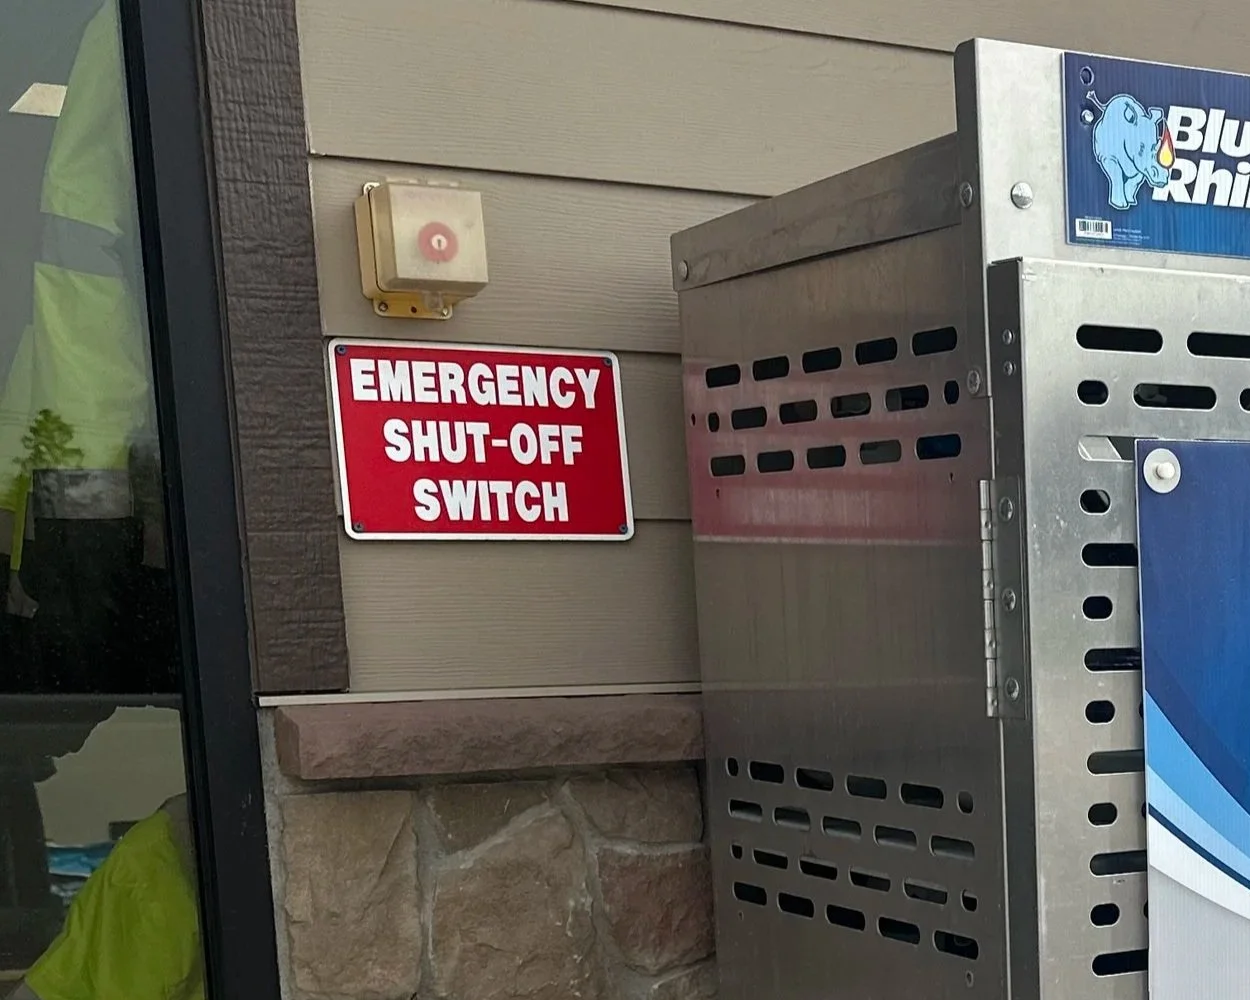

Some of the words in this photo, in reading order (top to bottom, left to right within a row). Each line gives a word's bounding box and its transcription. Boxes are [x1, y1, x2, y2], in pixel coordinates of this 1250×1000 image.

[349, 358, 600, 409] EMERGENCY
[383, 418, 584, 465] SHUT-OFF
[412, 478, 569, 522] SWITCH
